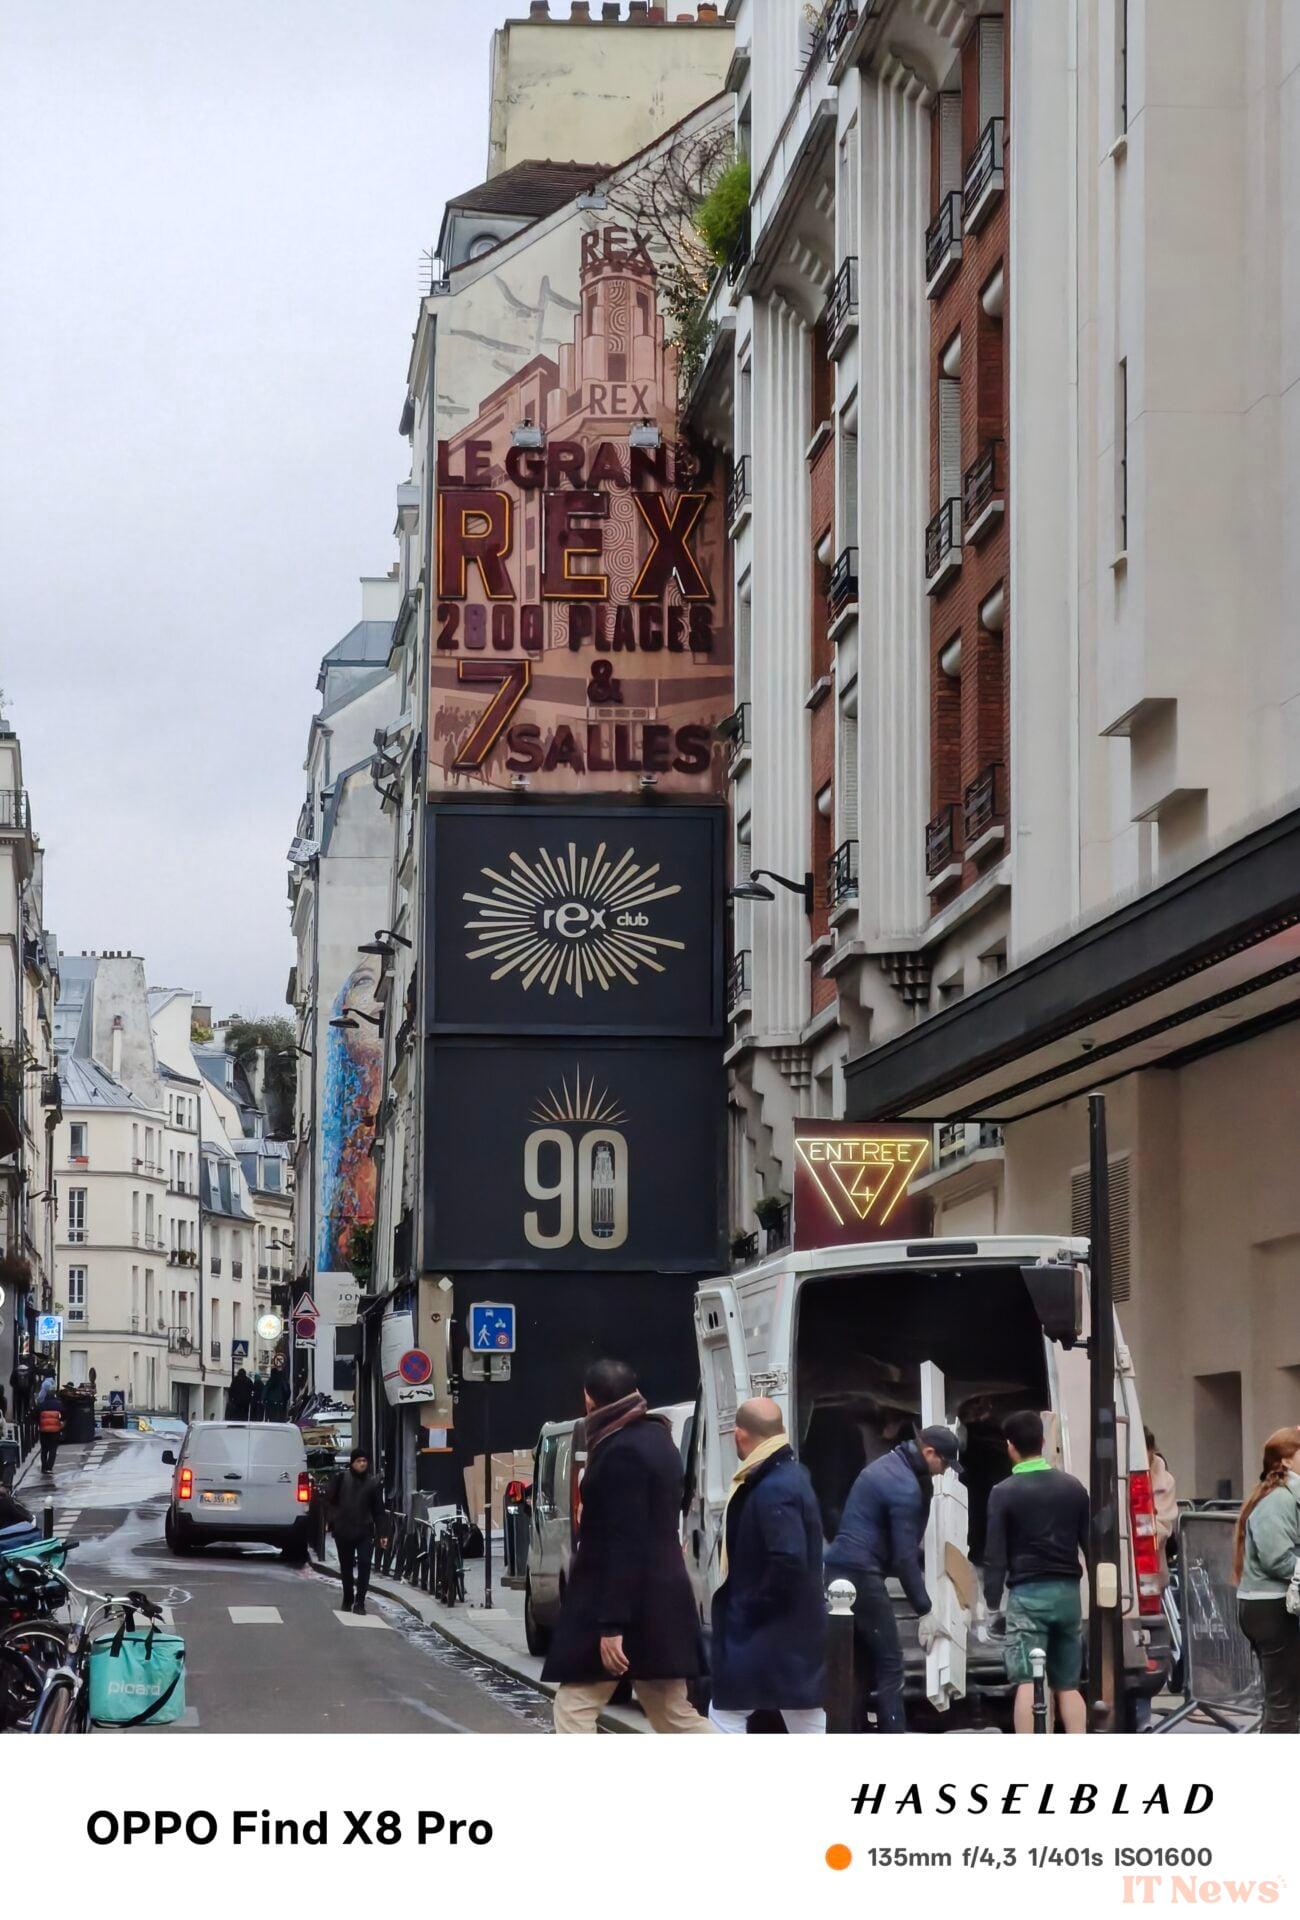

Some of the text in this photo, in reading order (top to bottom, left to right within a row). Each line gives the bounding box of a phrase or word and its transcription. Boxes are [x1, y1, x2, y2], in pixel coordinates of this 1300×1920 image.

[581, 226, 655, 269] REX
[589, 383, 649, 417] REX
[437, 440, 492, 487] LE
[437, 489, 713, 601] REX
[437, 603, 713, 652] 2800 PLACES
[587, 659, 624, 703] &
[452, 657, 712, 774] 7 SALLES
[543, 903, 649, 938] rex club
[809, 1142, 912, 1162] ENTREE
[524, 1129, 628, 1249] 90
[850, 1165, 875, 1202] 4
